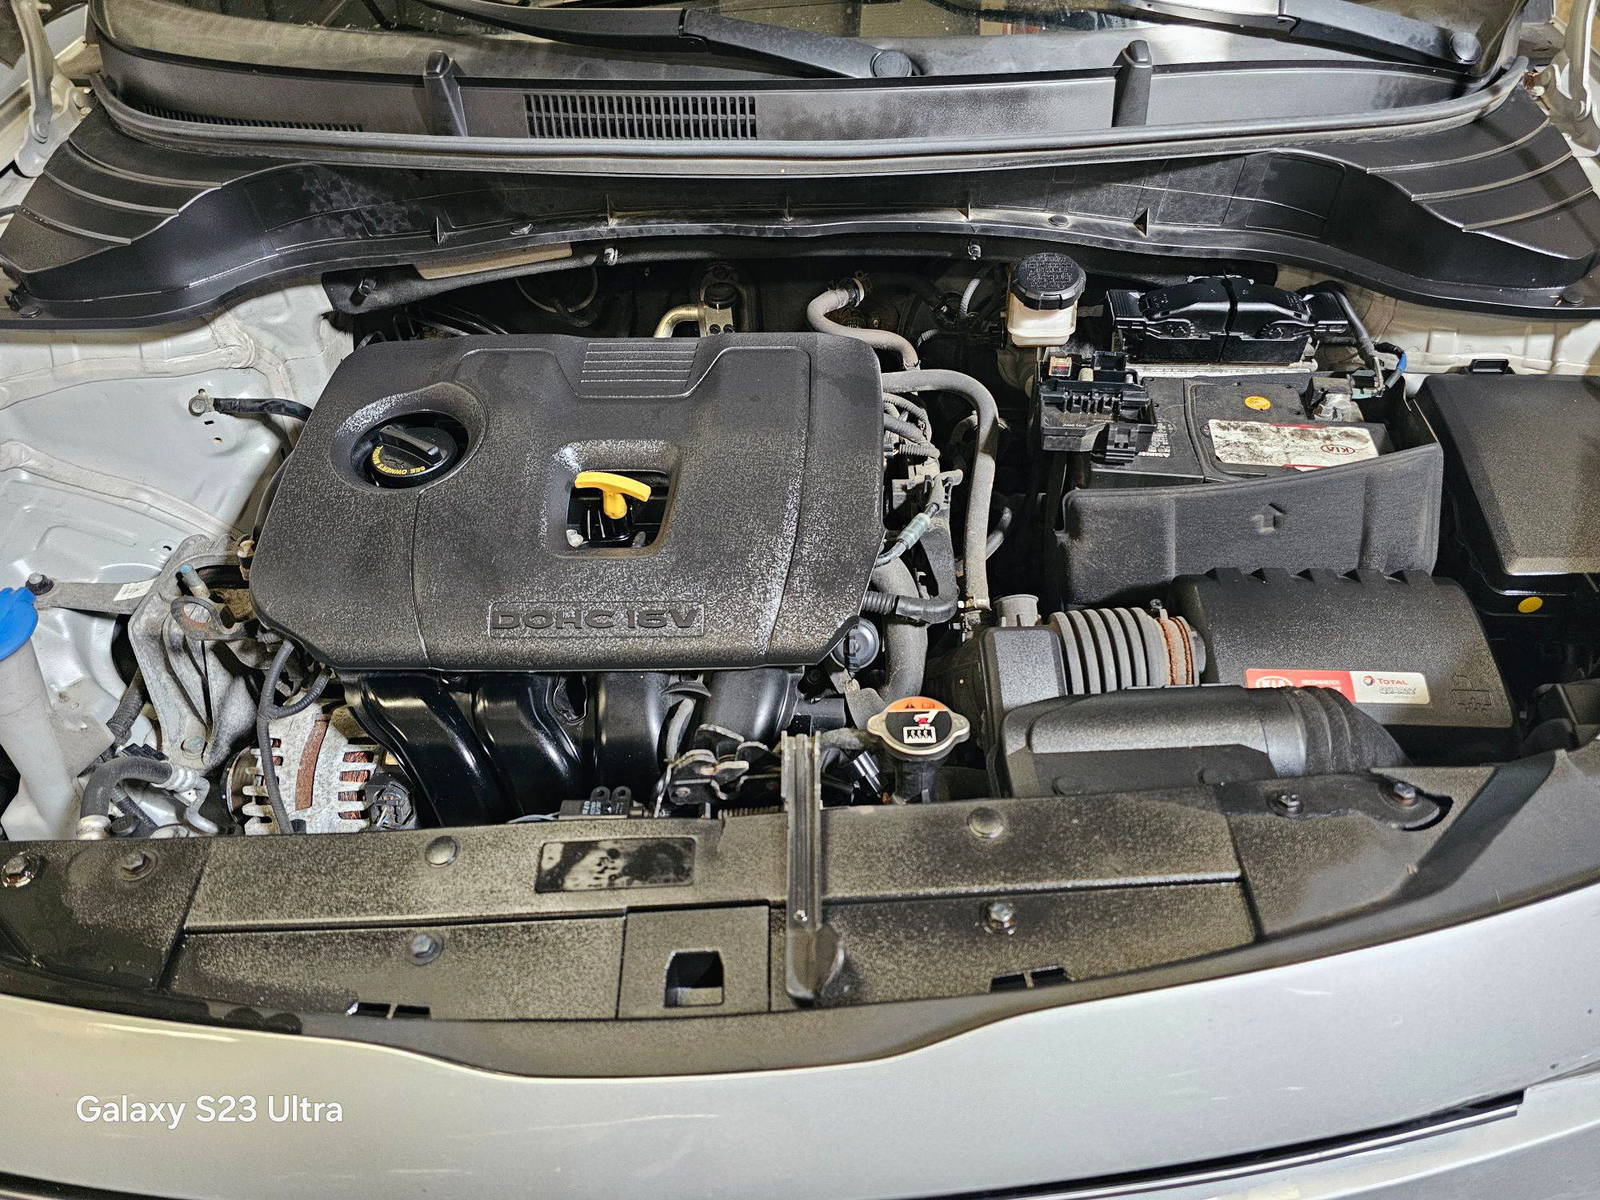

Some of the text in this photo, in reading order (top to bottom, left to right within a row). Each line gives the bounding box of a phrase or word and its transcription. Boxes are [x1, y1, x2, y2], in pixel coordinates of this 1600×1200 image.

[1324, 445, 1352, 454] KIA
[492, 609, 698, 630] DOHC 16V
[1377, 678, 1409, 686] TOTAL
